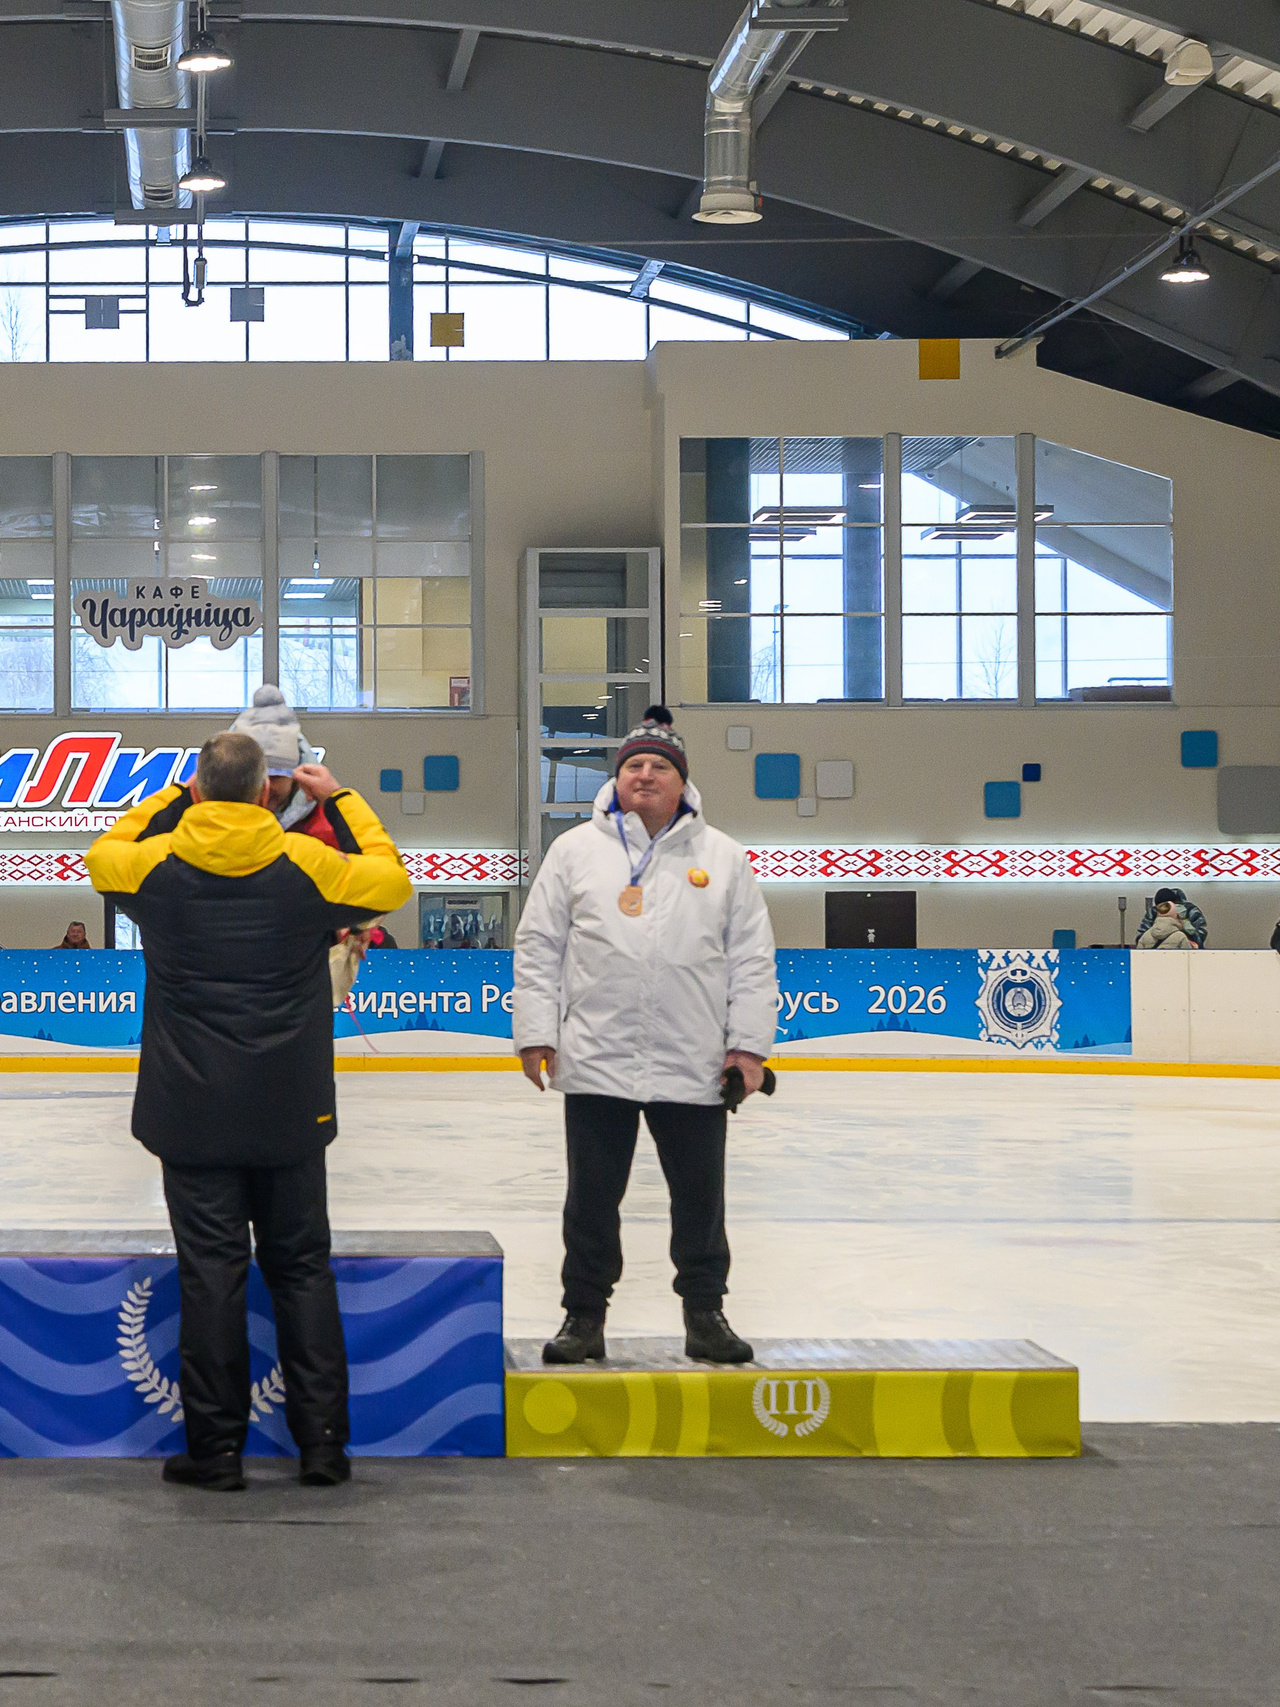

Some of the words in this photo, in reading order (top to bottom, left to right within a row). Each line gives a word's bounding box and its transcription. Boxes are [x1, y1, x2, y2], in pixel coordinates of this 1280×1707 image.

[136, 585, 200, 599] КАФЕ
[81, 598, 255, 642] Чараўніца
[333, 990, 472, 1019] зидента
[867, 985, 947, 1014] 2026
[765, 1380, 818, 1415] III
